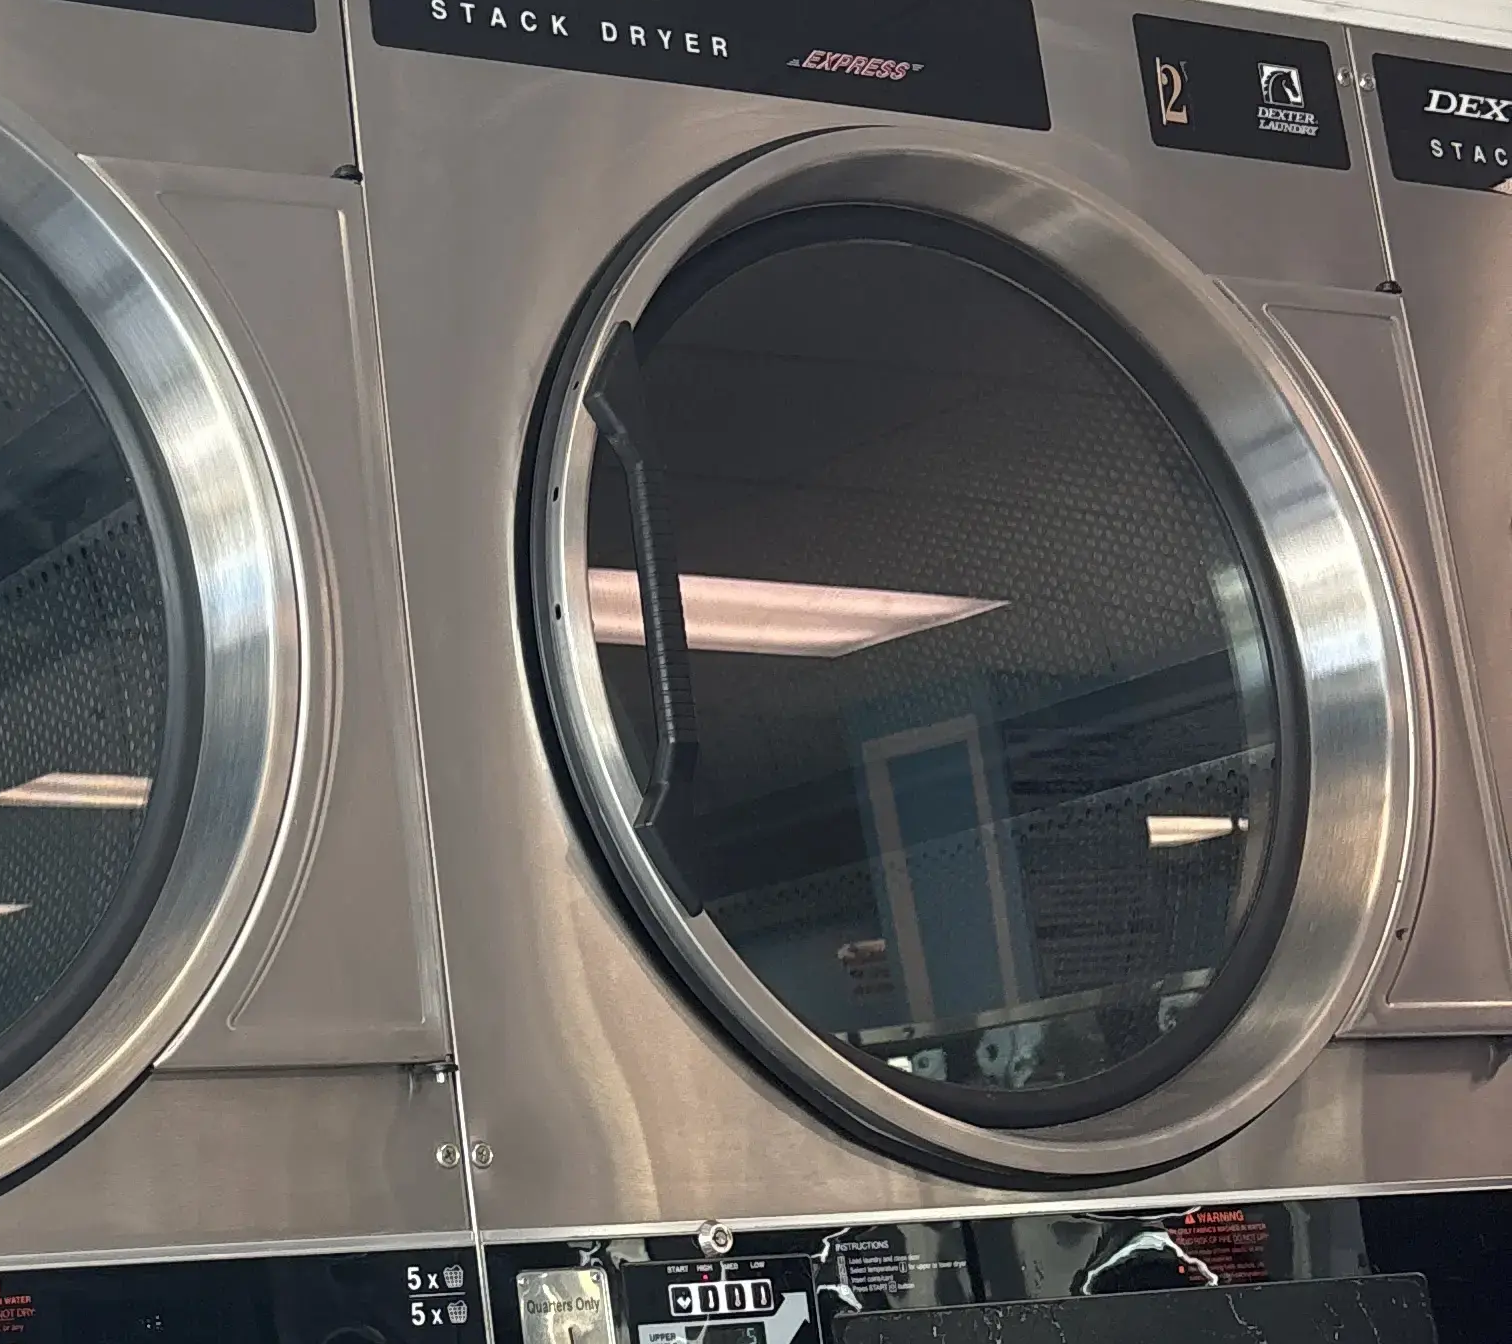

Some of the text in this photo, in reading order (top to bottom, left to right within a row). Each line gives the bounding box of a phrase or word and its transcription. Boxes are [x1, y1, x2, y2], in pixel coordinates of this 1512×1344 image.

[602, 22, 727, 57] DRYER
[802, 50, 910, 80] EXPRESS
[1159, 63, 1187, 124] 2
[1257, 107, 1317, 125] DEXTER
[1259, 120, 1319, 136] LAUNDRY
[1197, 1210, 1244, 1223] WARNING
[835, 1240, 889, 1252] INSTRUCTIONS
[696, 1264, 713, 1272] HIGH
[750, 1261, 765, 1269] LOW
[407, 1266, 439, 1290] 5 x
[4, 1296, 31, 1304] WATER
[527, 1296, 600, 1314] Quarters Only
[411, 1302, 443, 1326] 5 x
[649, 1333, 676, 1342] UPPER
